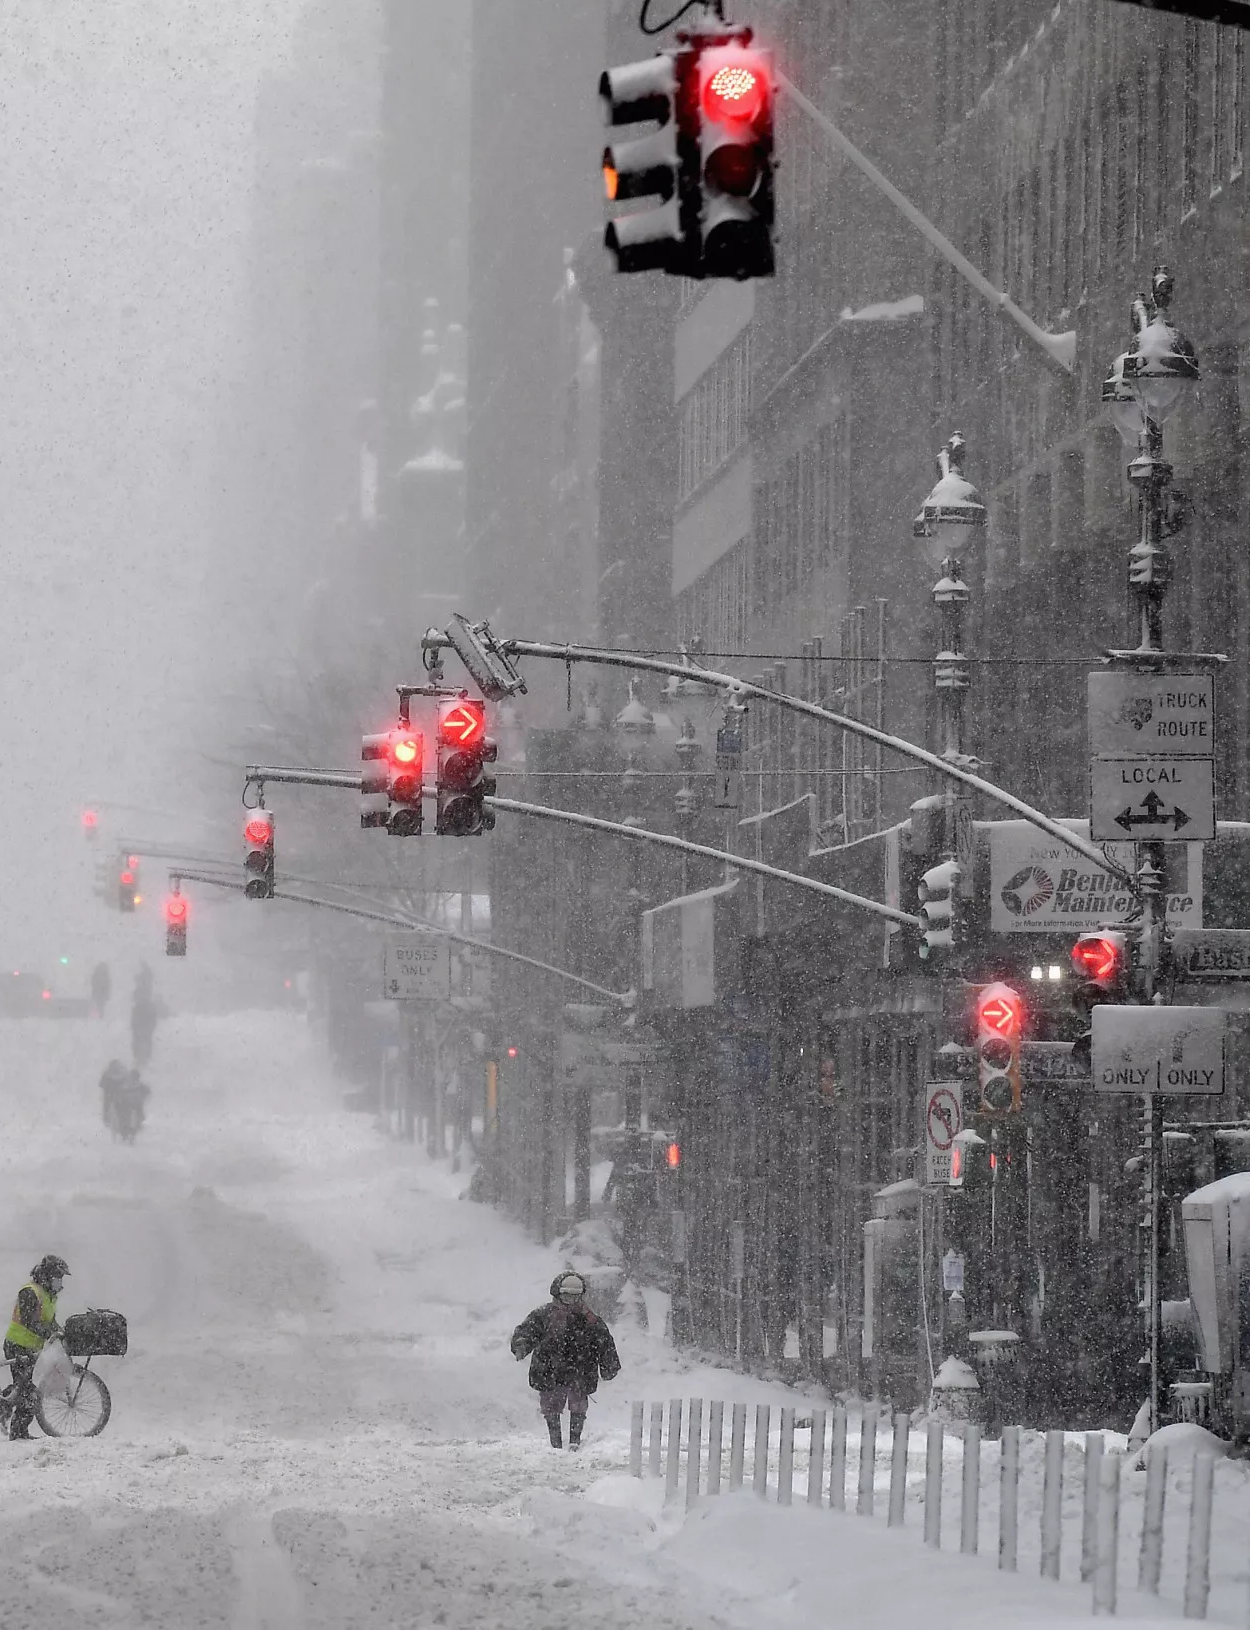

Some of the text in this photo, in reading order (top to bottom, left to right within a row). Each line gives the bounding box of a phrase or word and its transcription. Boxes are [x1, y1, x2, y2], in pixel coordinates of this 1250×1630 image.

[1157, 693, 1207, 708] TRUCK
[1157, 721, 1207, 737] ROUTE
[1122, 768, 1182, 784] LOCAL
[1051, 893, 1193, 913] Maintence
[397, 949, 438, 961] BUSES
[401, 965, 432, 976] ONLY
[1102, 1068, 1214, 1086] ONLY ONLY
[933, 1168, 950, 1179] BUSE
